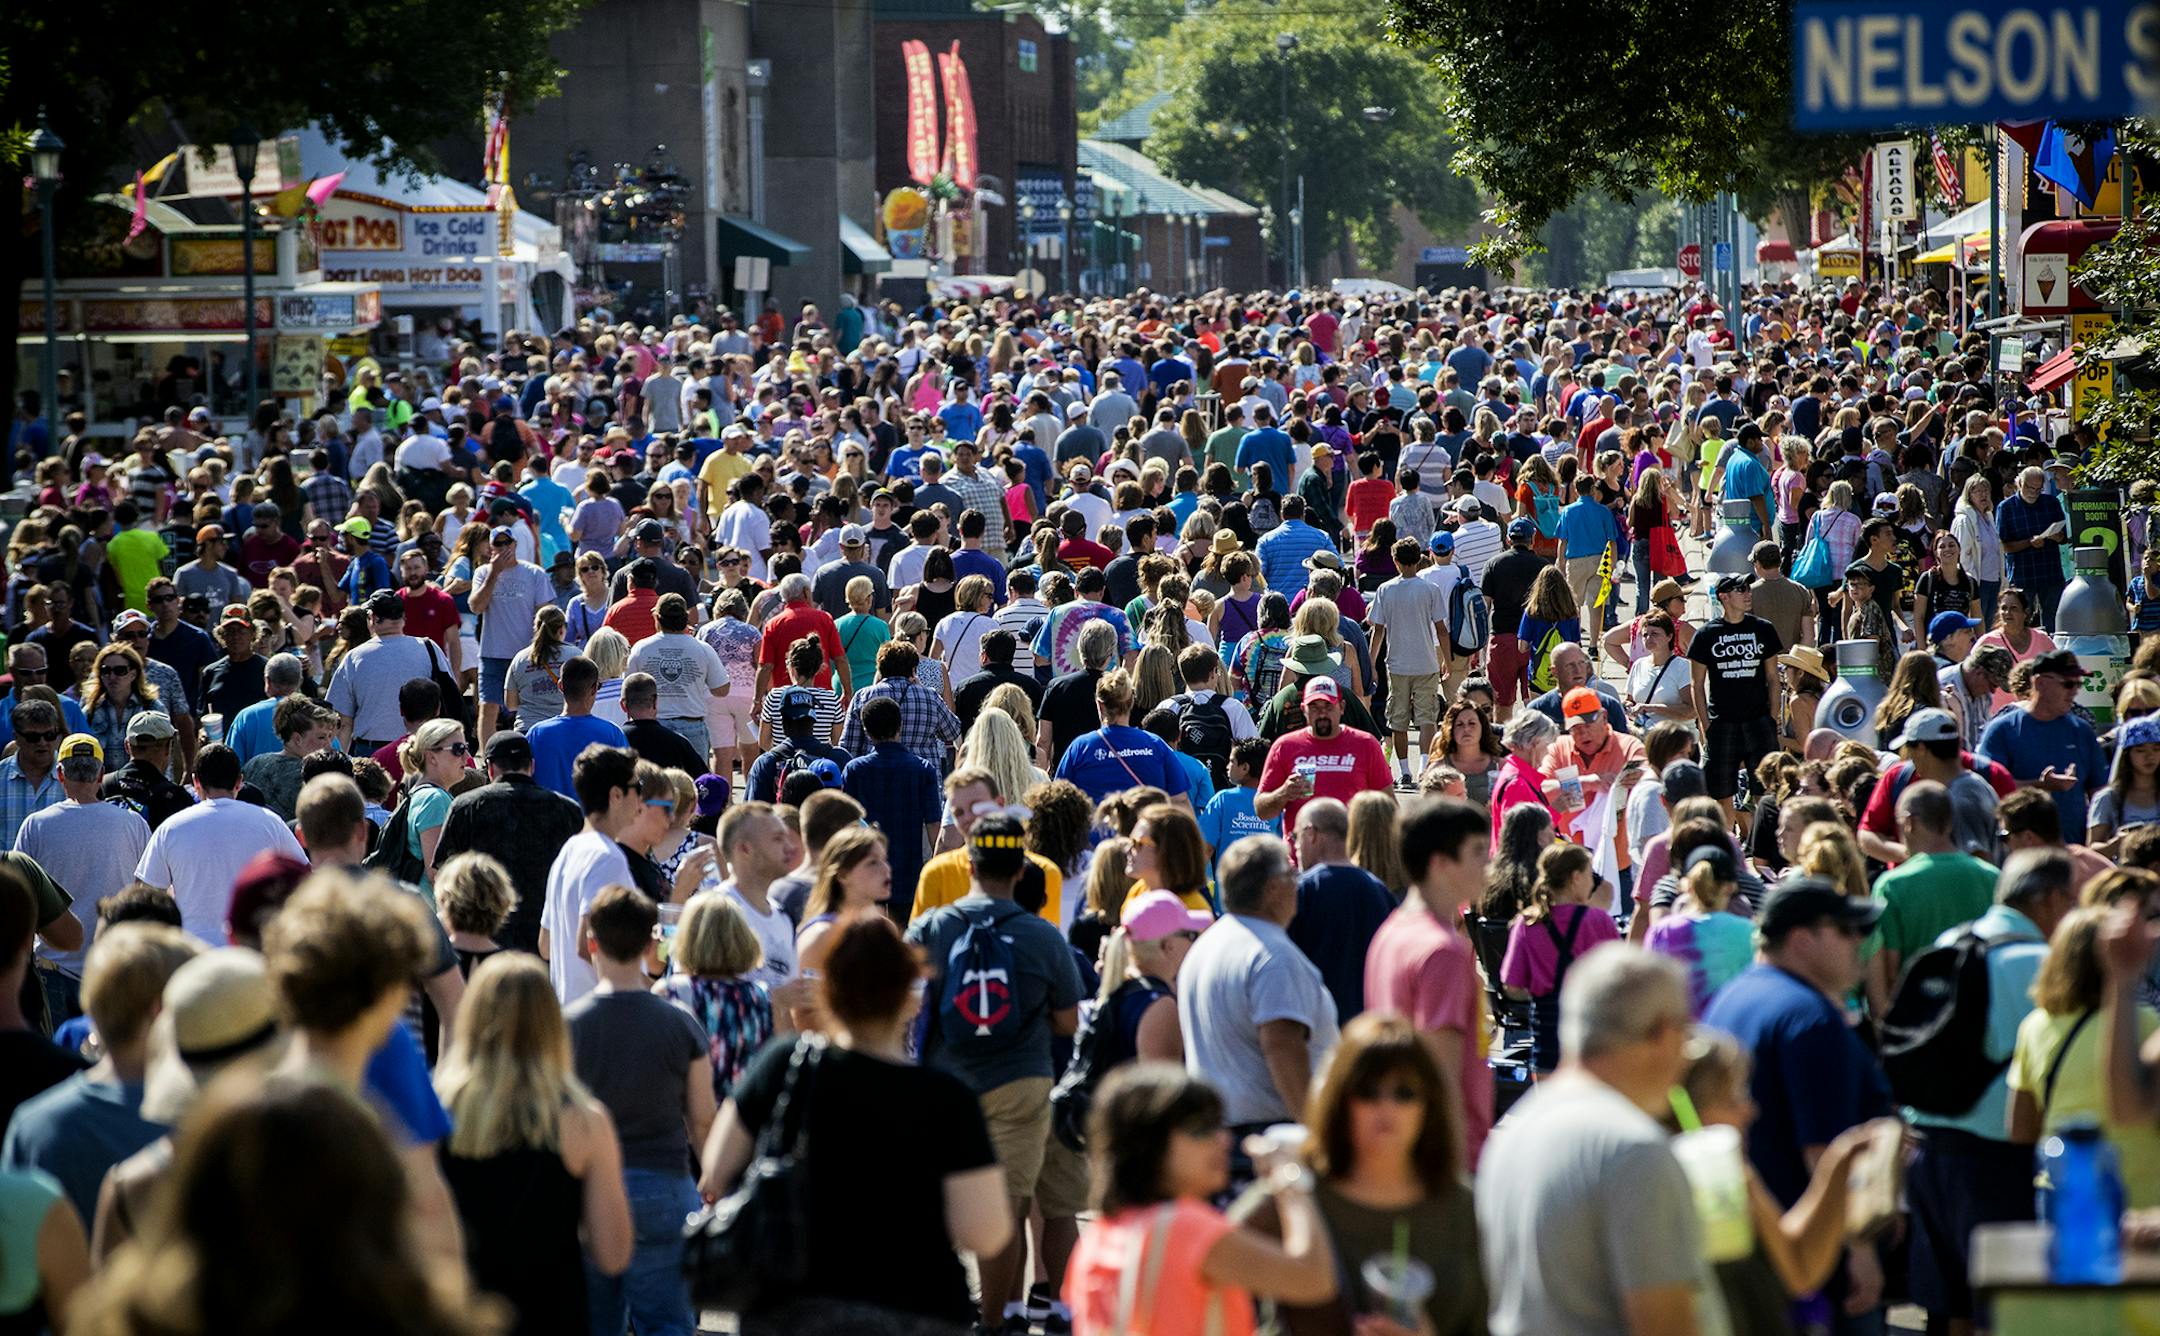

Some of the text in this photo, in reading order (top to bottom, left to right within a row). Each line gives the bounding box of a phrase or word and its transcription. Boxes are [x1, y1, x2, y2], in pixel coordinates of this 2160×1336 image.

[1803, 8, 2099, 112] NELSON
[1887, 147, 1904, 216] ALPACAS
[322, 215, 397, 248] OT DOG
[414, 216, 485, 236] Ice Cold
[422, 238, 478, 255] Drinks
[1680, 253, 1701, 268] STO
[361, 267, 405, 283] LONG
[409, 267, 443, 282] HOT
[447, 267, 483, 282] DOG
[2078, 365, 2109, 382] POP
[2071, 501, 2118, 511] INFORMATION
[2084, 512, 2108, 521] BOOTH
[1711, 642, 1765, 660] Google
[791, 693, 813, 706] NAVY
[1295, 755, 1340, 766] CASE
